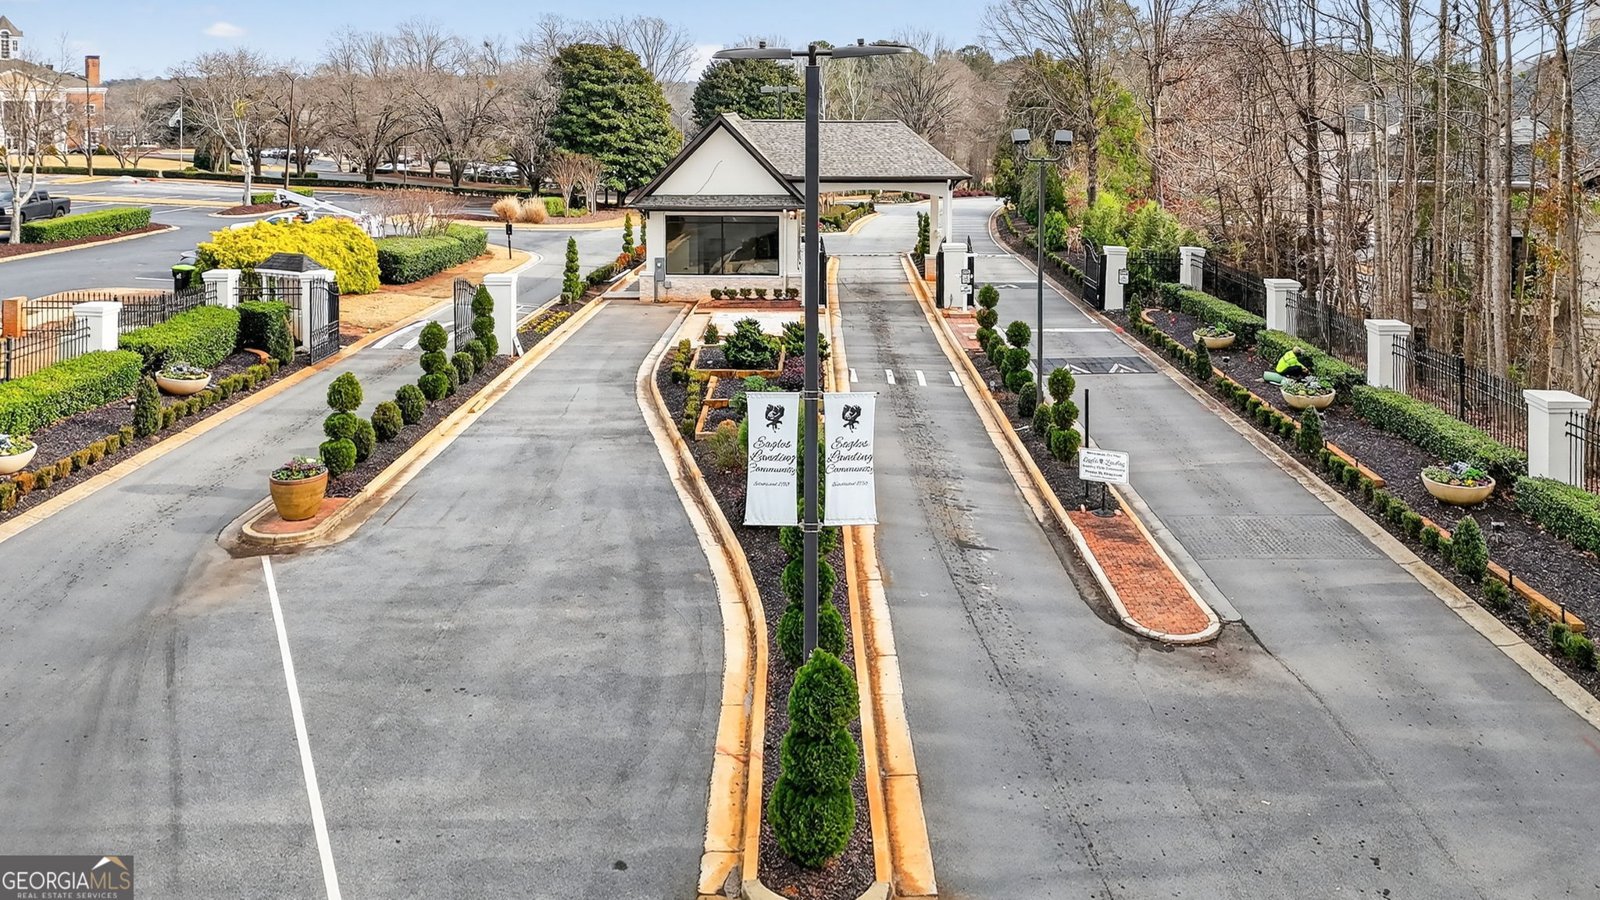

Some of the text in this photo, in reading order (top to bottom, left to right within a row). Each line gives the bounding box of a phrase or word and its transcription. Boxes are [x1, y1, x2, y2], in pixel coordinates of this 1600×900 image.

[753, 436, 792, 451] Eagles
[831, 436, 869, 451] Eagles
[750, 450, 796, 465] Landing
[827, 450, 873, 464] Landing
[749, 462, 796, 475] Community
[825, 463, 873, 475] Community
